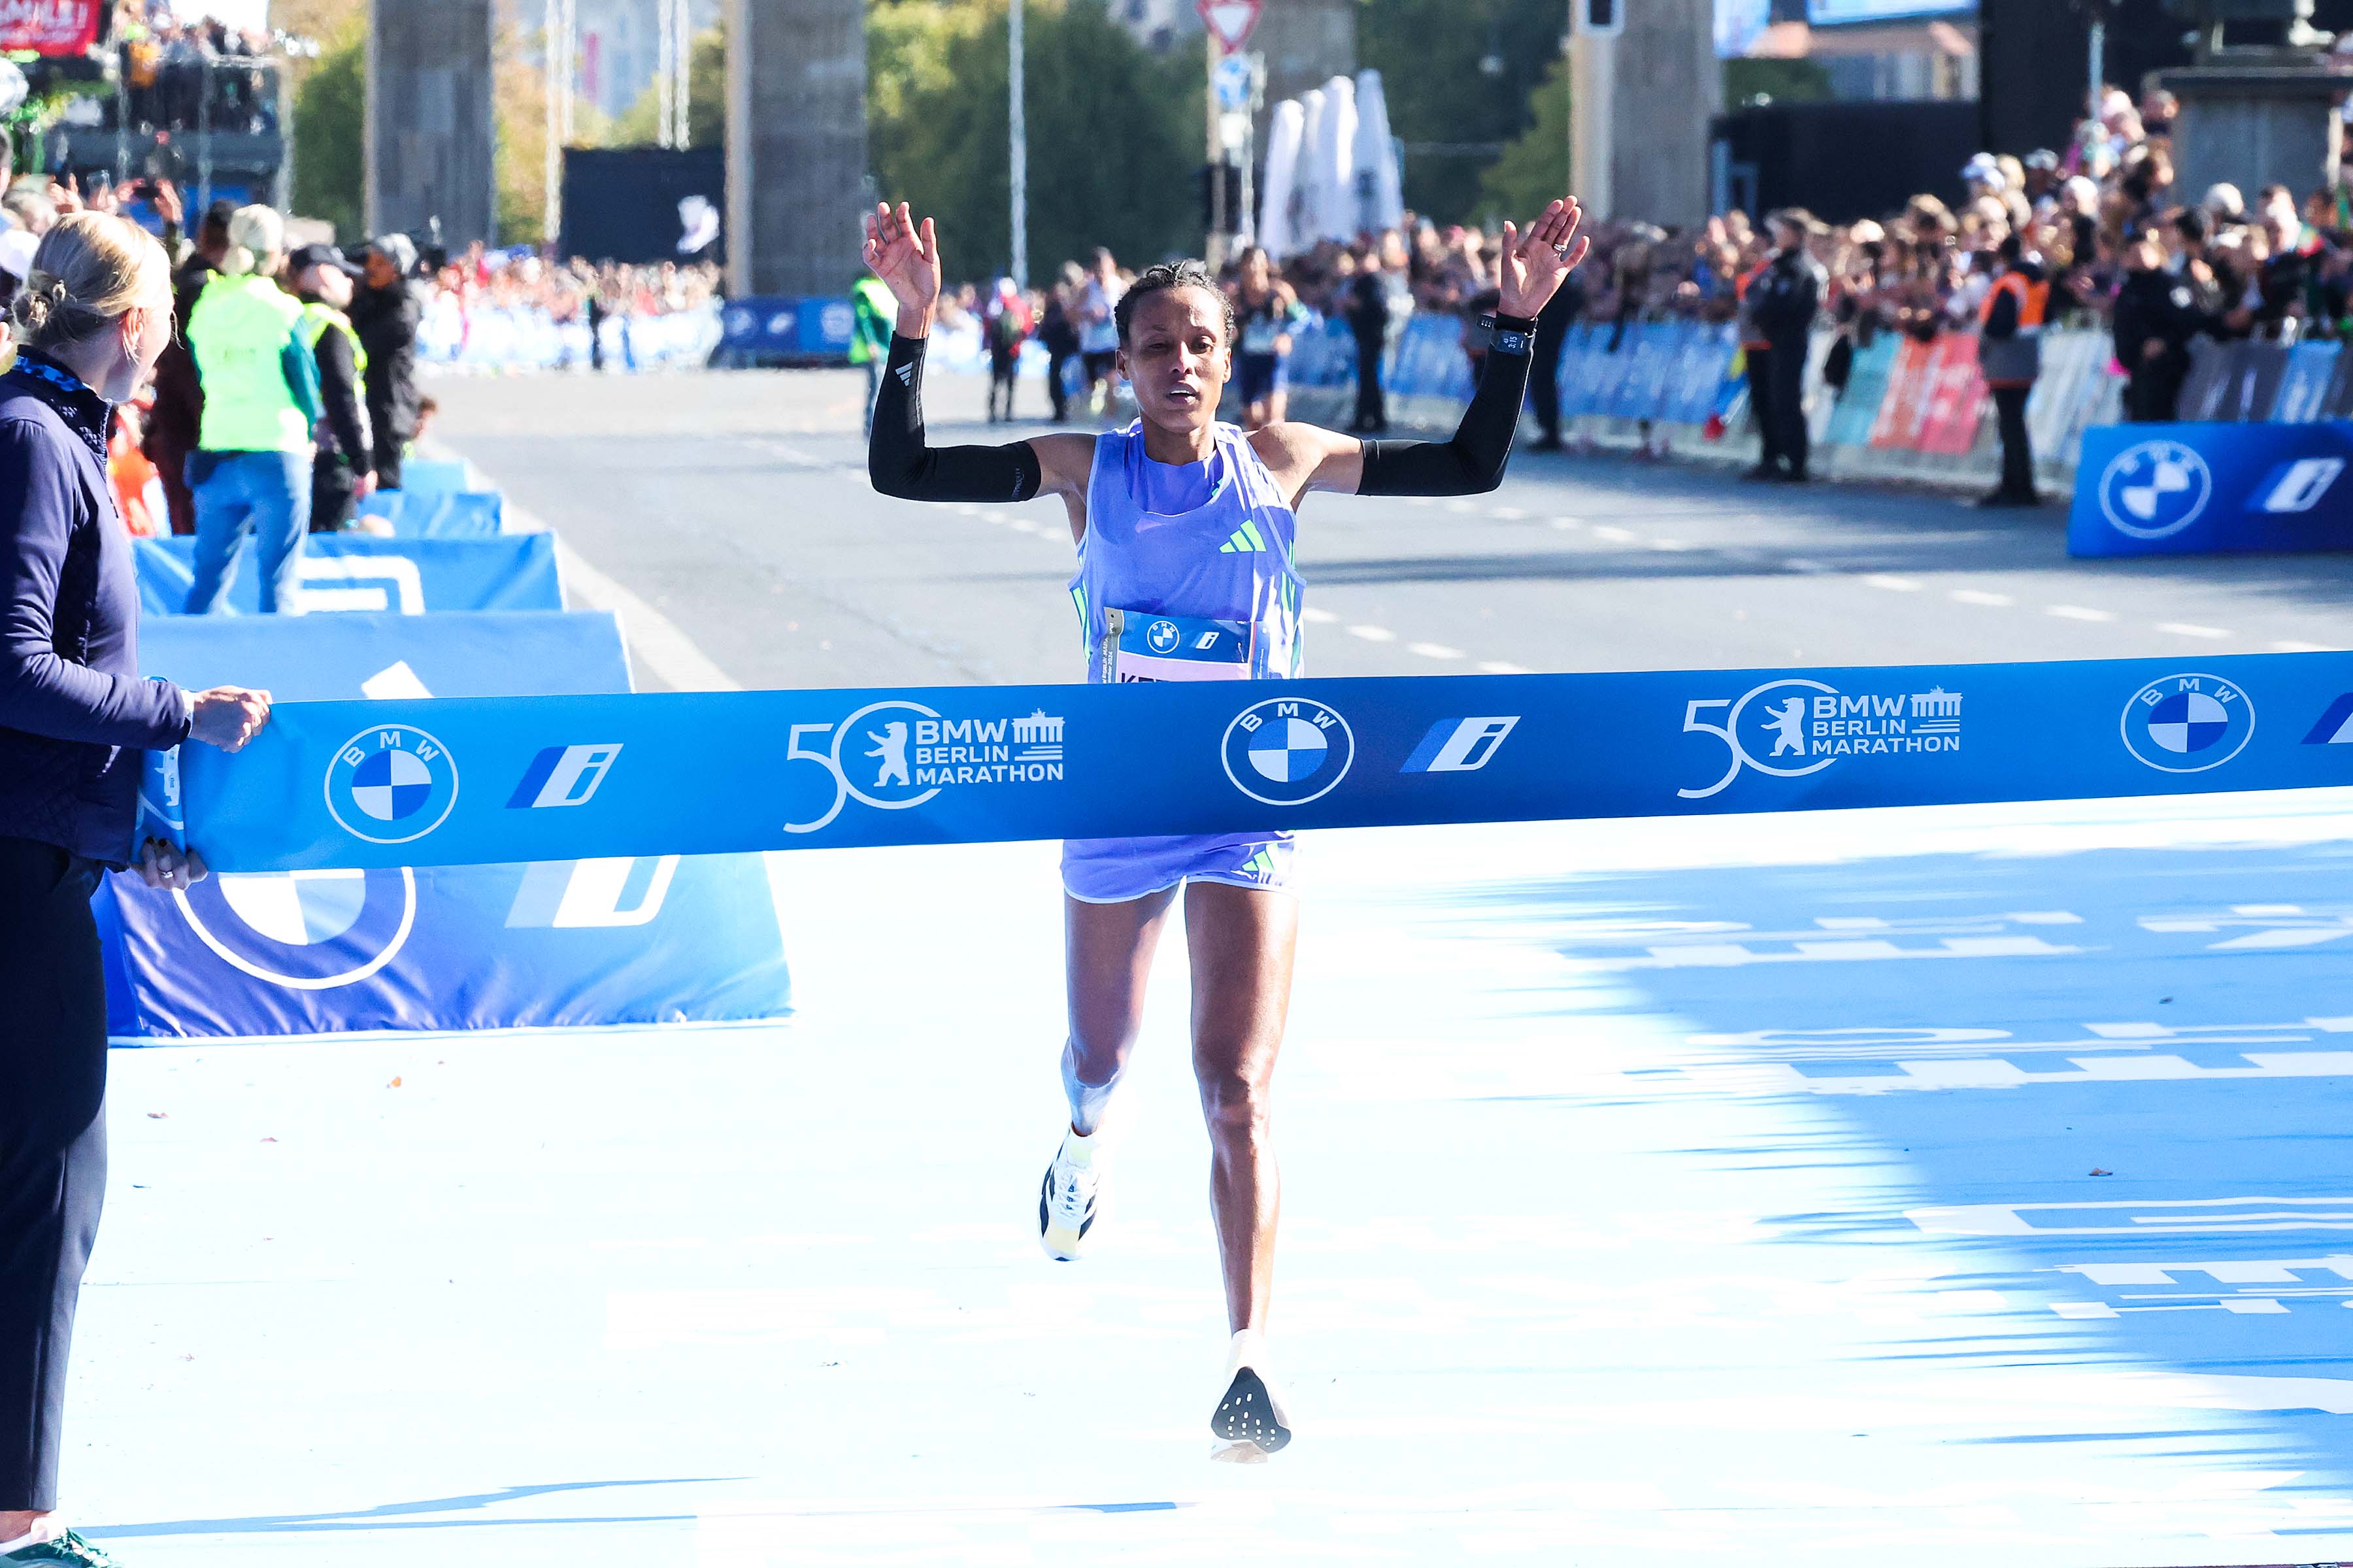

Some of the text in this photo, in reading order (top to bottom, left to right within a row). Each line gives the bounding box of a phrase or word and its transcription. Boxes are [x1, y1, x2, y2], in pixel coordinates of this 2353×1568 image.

[1508, 336, 1518, 349] 3:15
[2141, 678, 2239, 707] BMW
[1812, 693, 1907, 718] BMW
[1239, 703, 1337, 733] BMW
[1812, 719, 1906, 737] BERLIN
[916, 718, 1008, 745] BMW
[342, 731, 440, 767] BMW
[916, 745, 1009, 765] BERLIN
[1812, 736, 1960, 756] MARATHON
[916, 763, 1064, 786] MARATHON
